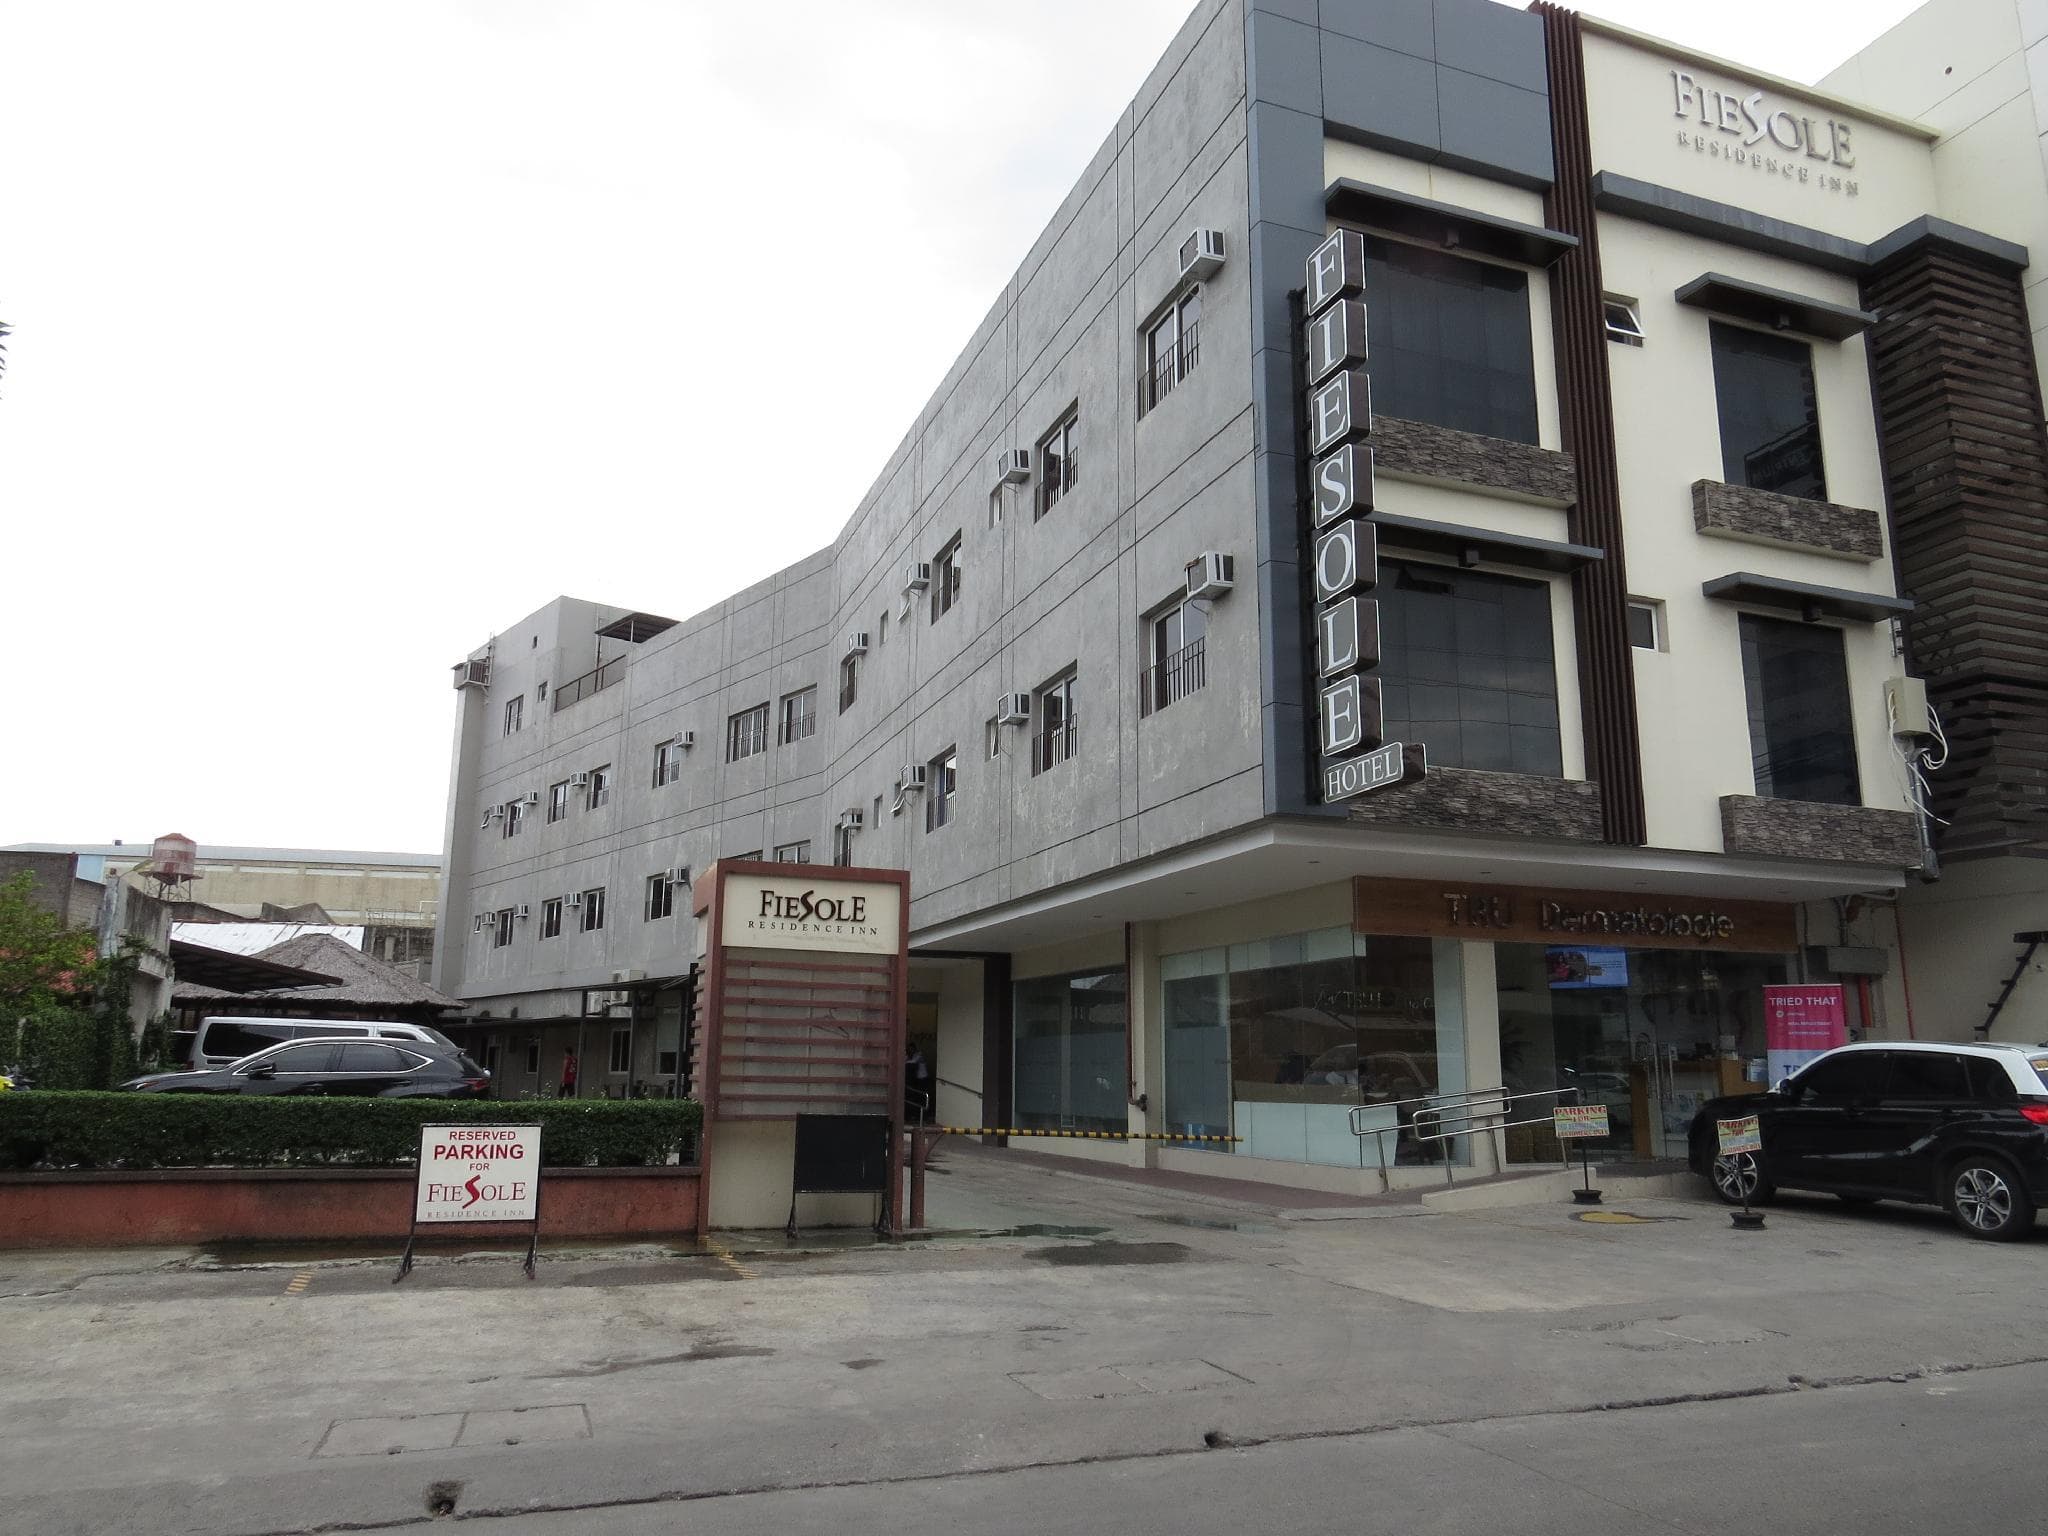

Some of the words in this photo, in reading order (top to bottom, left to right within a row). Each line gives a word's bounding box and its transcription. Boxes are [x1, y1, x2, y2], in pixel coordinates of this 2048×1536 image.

[1671, 70, 1856, 169] FIESOLE
[1677, 129, 1810, 184] RESIDENCE
[1818, 173, 1860, 197] INN
[1309, 236, 1357, 751] FIESOLE
[1327, 751, 1400, 797] HOTEL
[759, 889, 866, 923] FIESOLE
[748, 920, 842, 933] RESIDENCE
[851, 927, 878, 935] INN
[1769, 996, 1803, 1007] TRIED
[1806, 996, 1837, 1006] THAT
[1555, 1106, 1606, 1115] PARKING
[1719, 1117, 1759, 1129] PARKING
[449, 1131, 516, 1141] RESERVED
[433, 1144, 524, 1160] PARKING
[469, 1162, 490, 1171] FOR
[425, 1174, 526, 1209] FIESOLE
[427, 1210, 497, 1218] RESIDENCE
